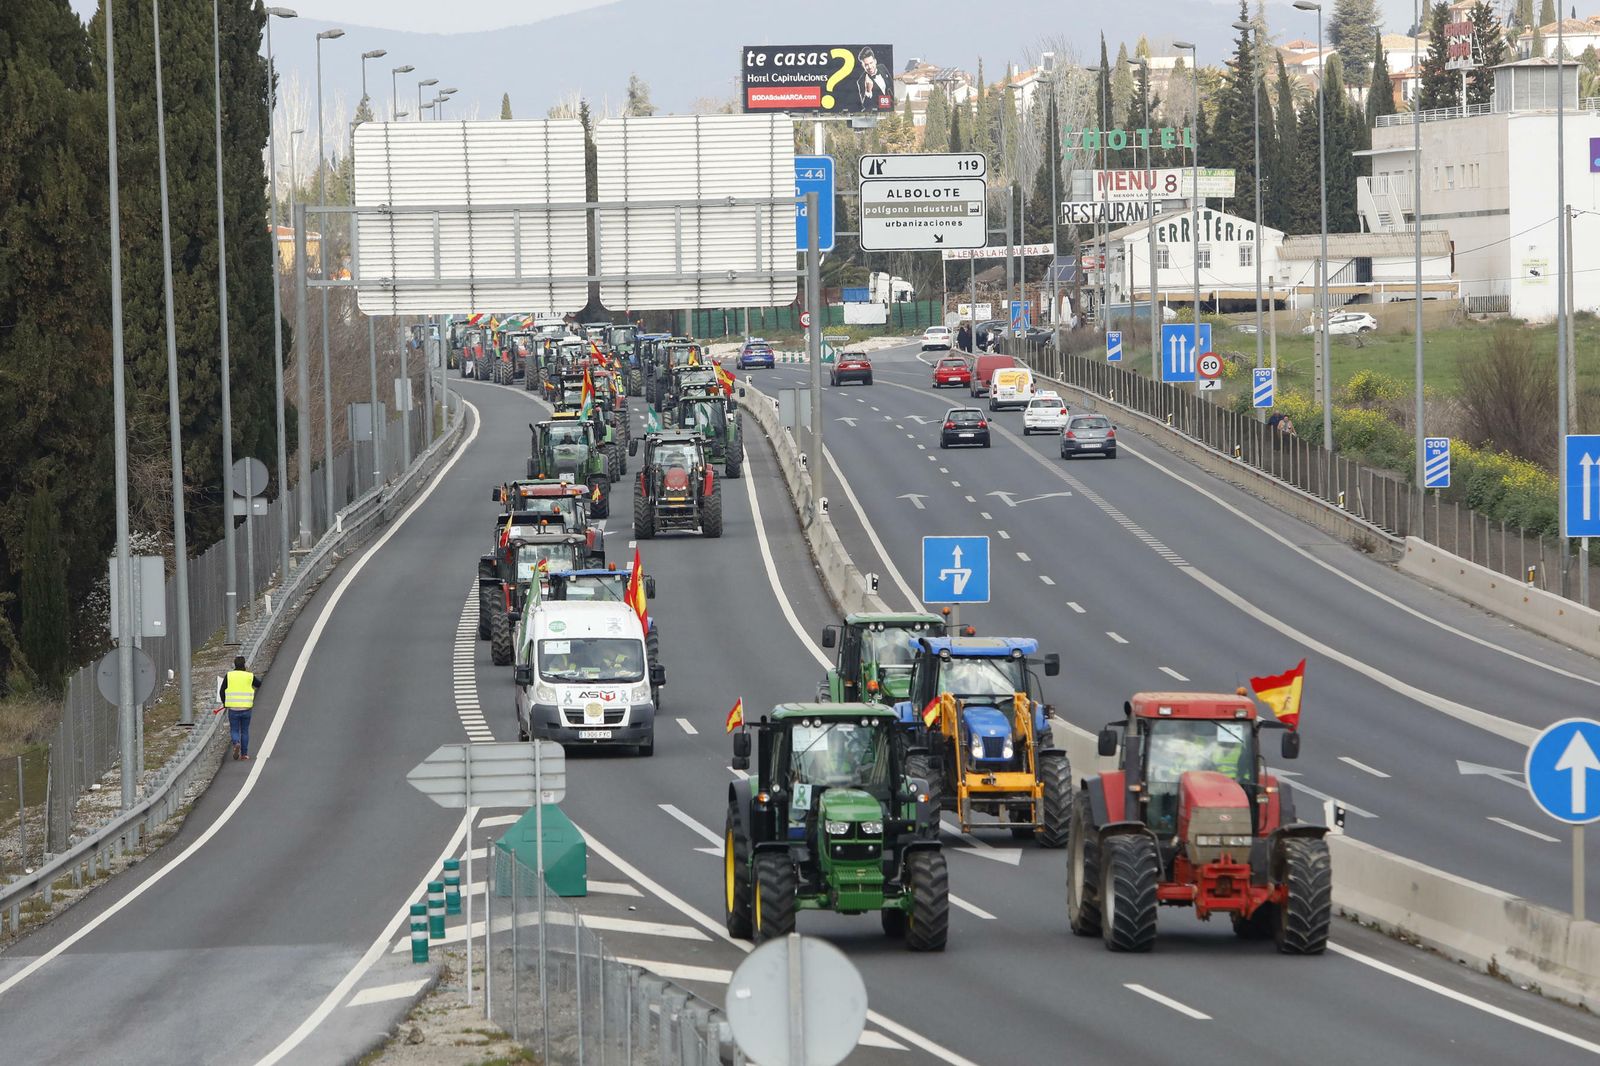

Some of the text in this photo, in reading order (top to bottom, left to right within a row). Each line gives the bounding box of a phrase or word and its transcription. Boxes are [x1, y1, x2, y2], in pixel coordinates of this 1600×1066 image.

[746, 50, 767, 67] te
[774, 51, 828, 66] casas
[1083, 127, 1195, 151] HOTEL
[957, 160, 979, 170] 119
[1097, 170, 1157, 191] MENU
[1165, 174, 1177, 193] 8
[887, 188, 960, 198] ALBOLOTE
[865, 203, 909, 215] polígono
[1062, 202, 1162, 224] RESTAURANTE
[885, 219, 963, 228] urbanizaciones
[1202, 361, 1218, 370] 80
[1427, 440, 1447, 449] 300
